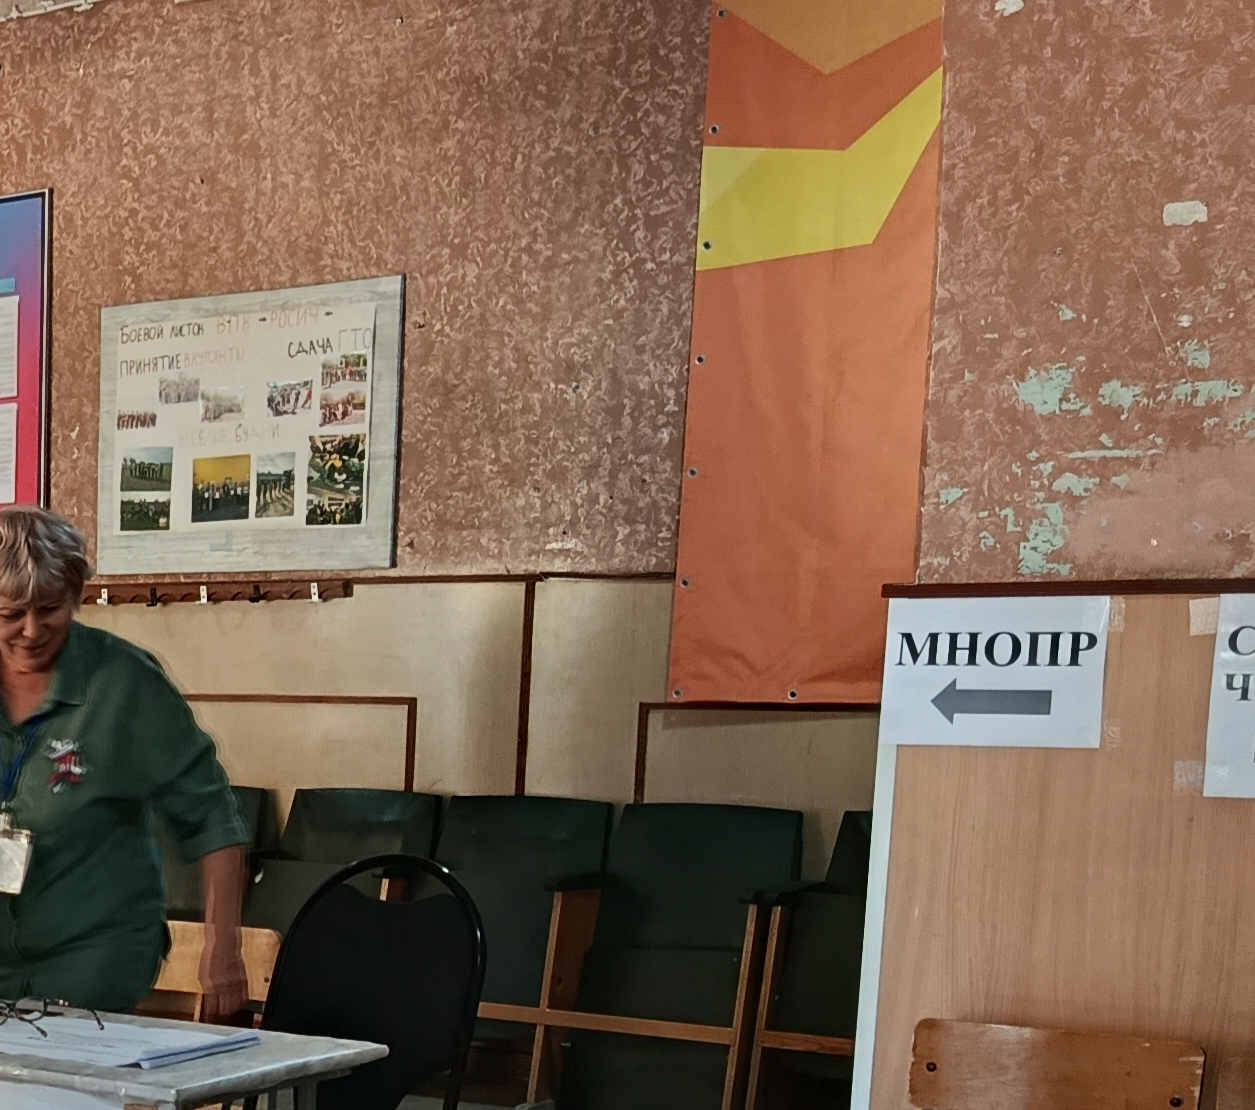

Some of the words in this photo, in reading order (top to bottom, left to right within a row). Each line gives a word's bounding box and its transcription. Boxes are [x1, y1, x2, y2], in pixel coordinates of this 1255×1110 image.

[287, 337, 334, 359] СДАЧА
[338, 328, 373, 351] ГТО
[119, 353, 182, 378] ПРИНЯТИЕ
[894, 631, 1098, 668] МНОПР
